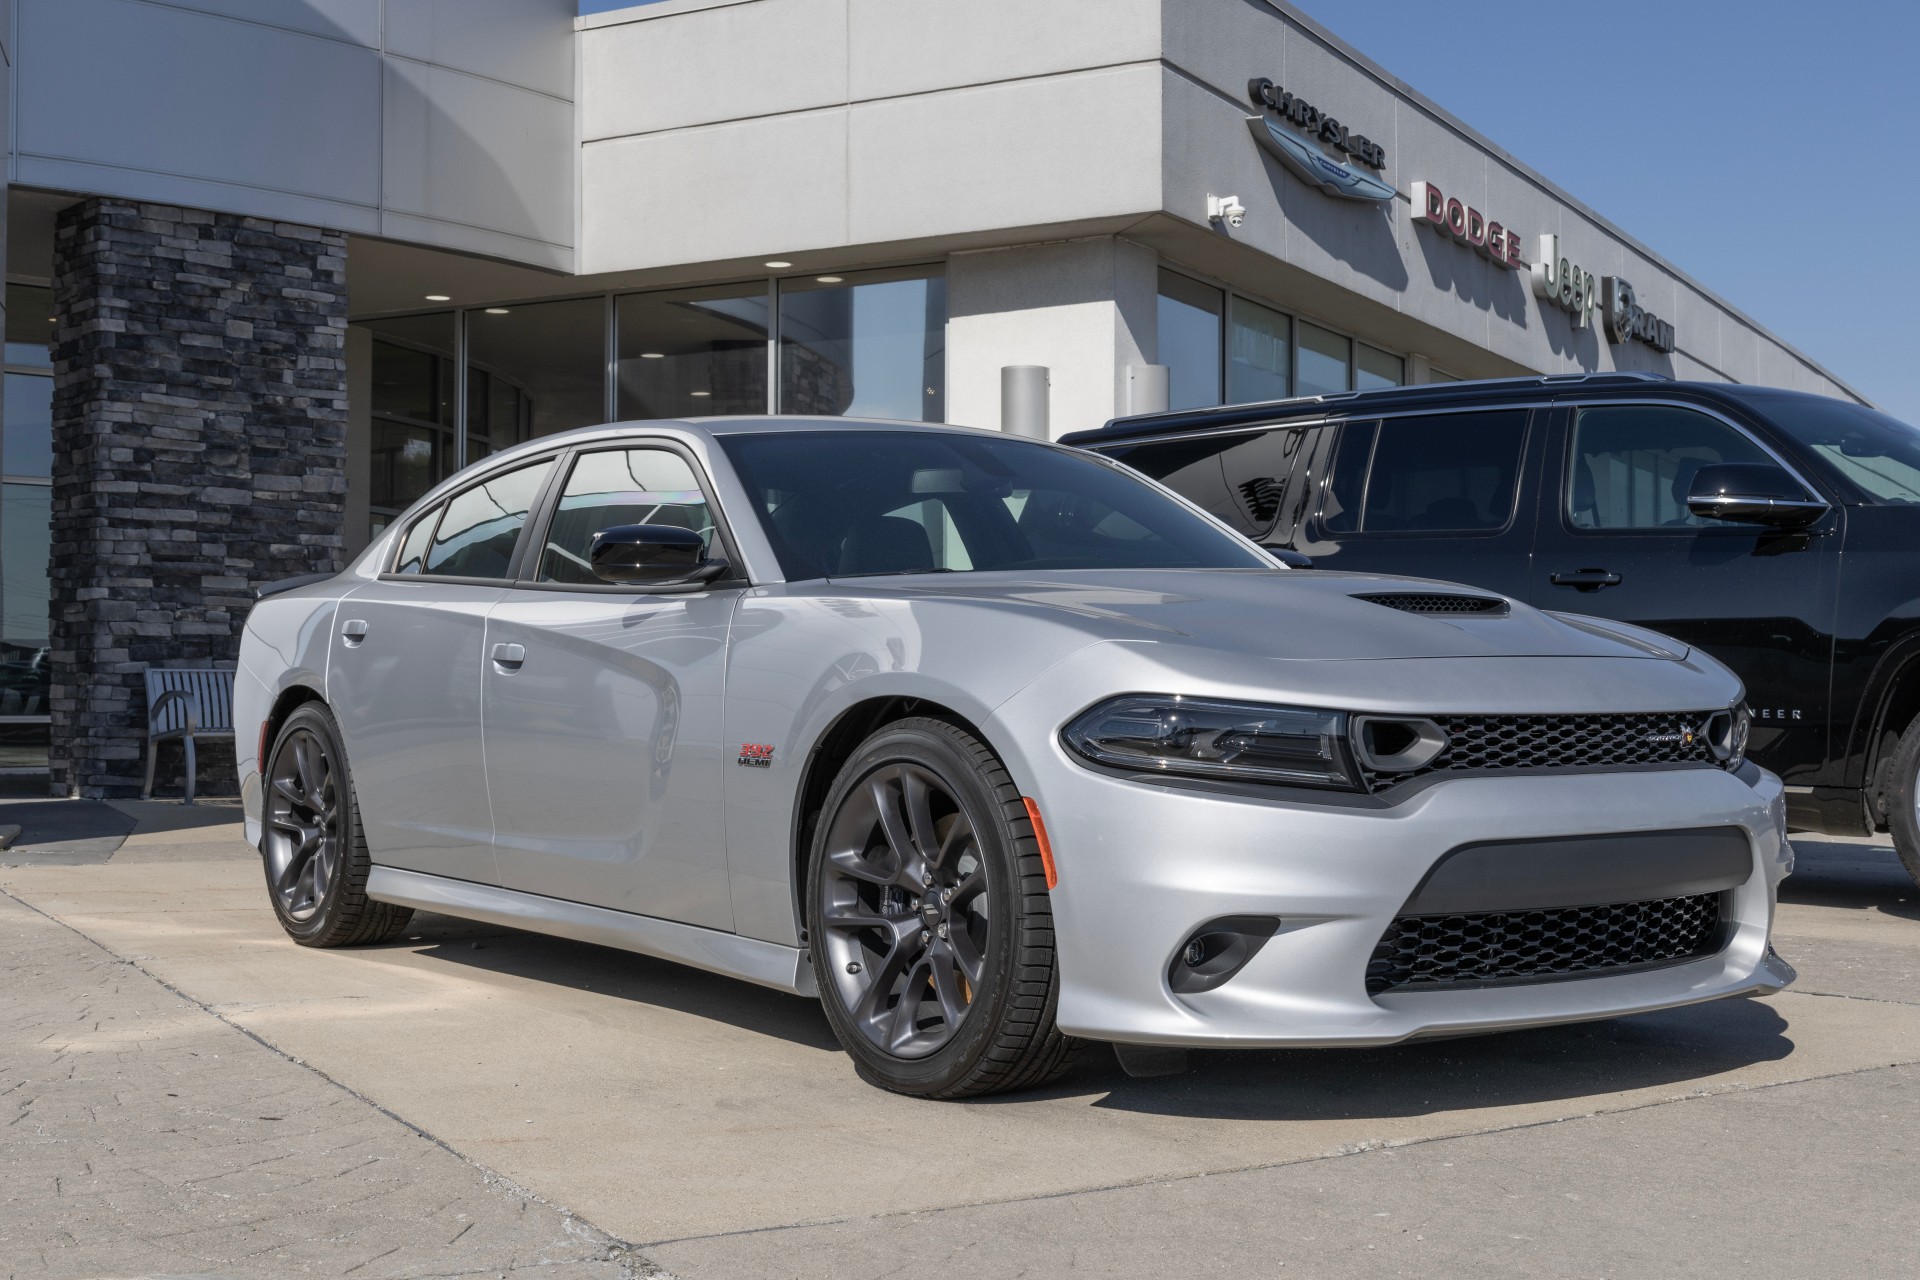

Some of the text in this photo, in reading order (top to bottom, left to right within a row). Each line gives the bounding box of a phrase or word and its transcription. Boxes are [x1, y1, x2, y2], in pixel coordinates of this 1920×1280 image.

[1249, 77, 1386, 170] CHRYSLER
[1411, 181, 1521, 270] DODGE
[1531, 234, 1596, 329] Jeep
[1632, 304, 1675, 353] RAM
[738, 758, 771, 768] HEMI
[740, 743, 775, 758] 392
